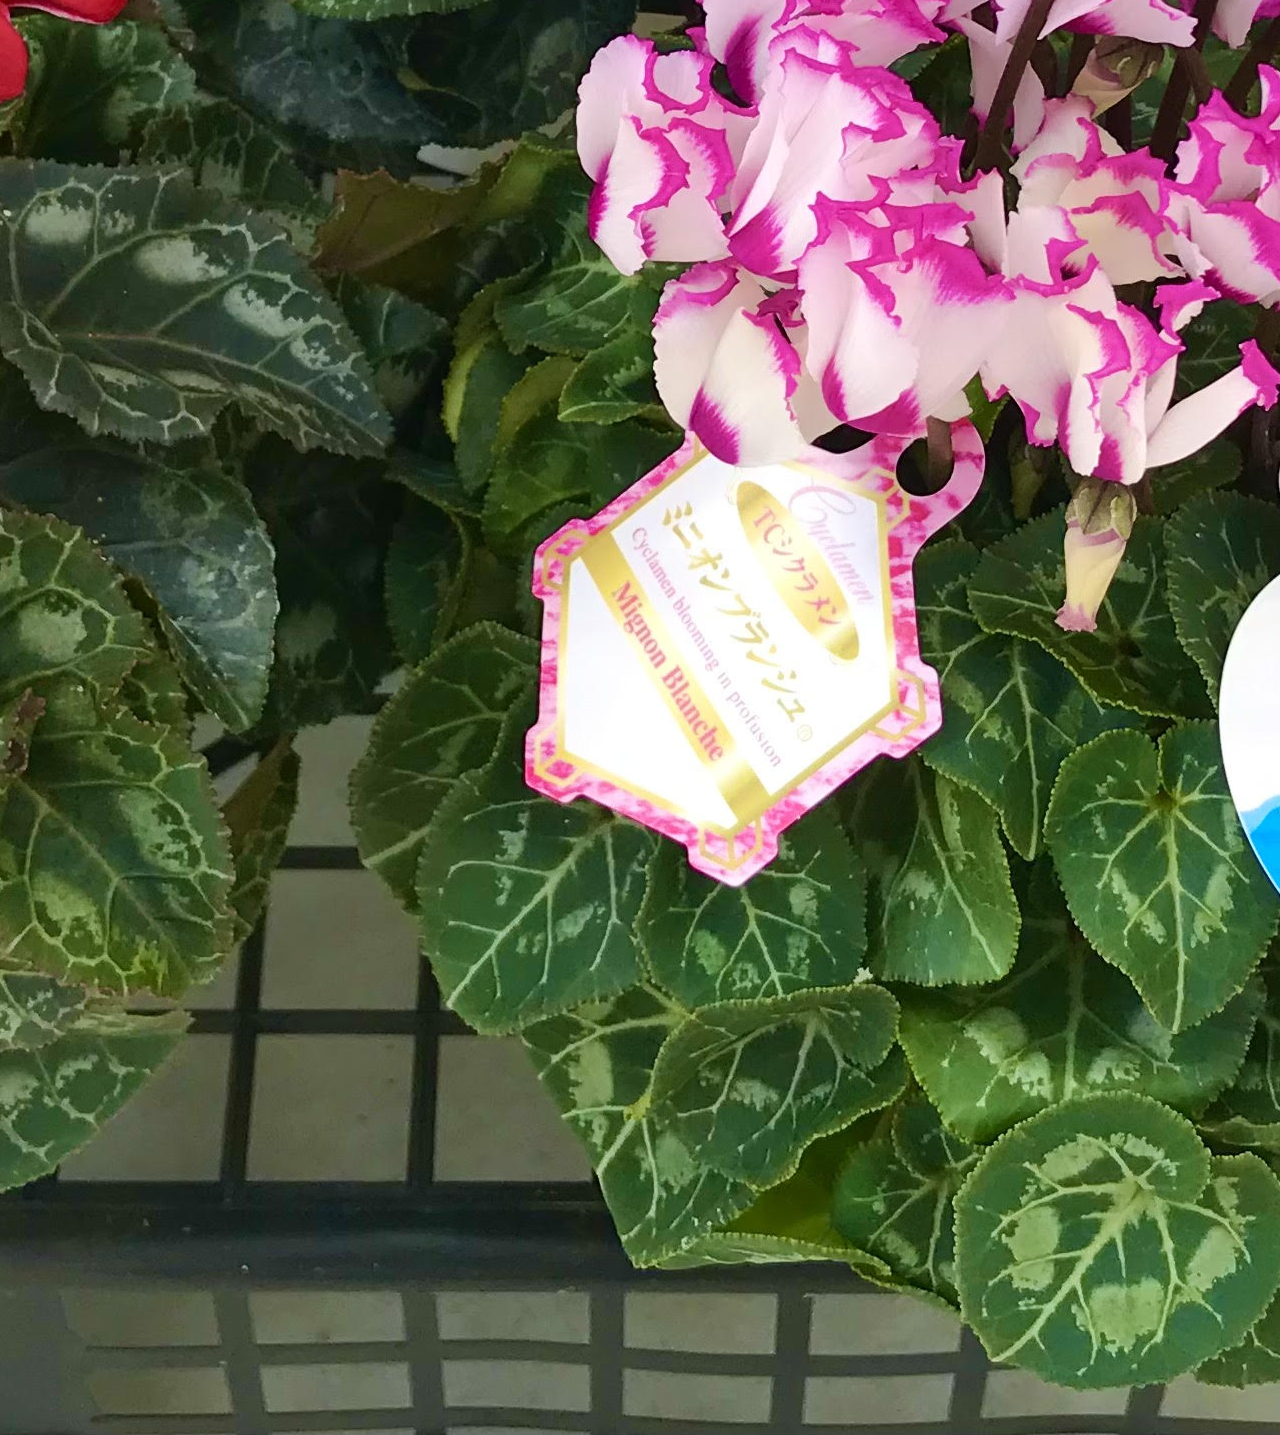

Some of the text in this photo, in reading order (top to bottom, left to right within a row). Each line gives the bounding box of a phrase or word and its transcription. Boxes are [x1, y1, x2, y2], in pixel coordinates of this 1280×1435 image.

[754, 506, 841, 625] TCシクラメン
[789, 483, 874, 603] Cyclamen
[612, 580, 724, 762] Mignon Blanche
[632, 527, 782, 768] Cyclamen blooming in profusion
